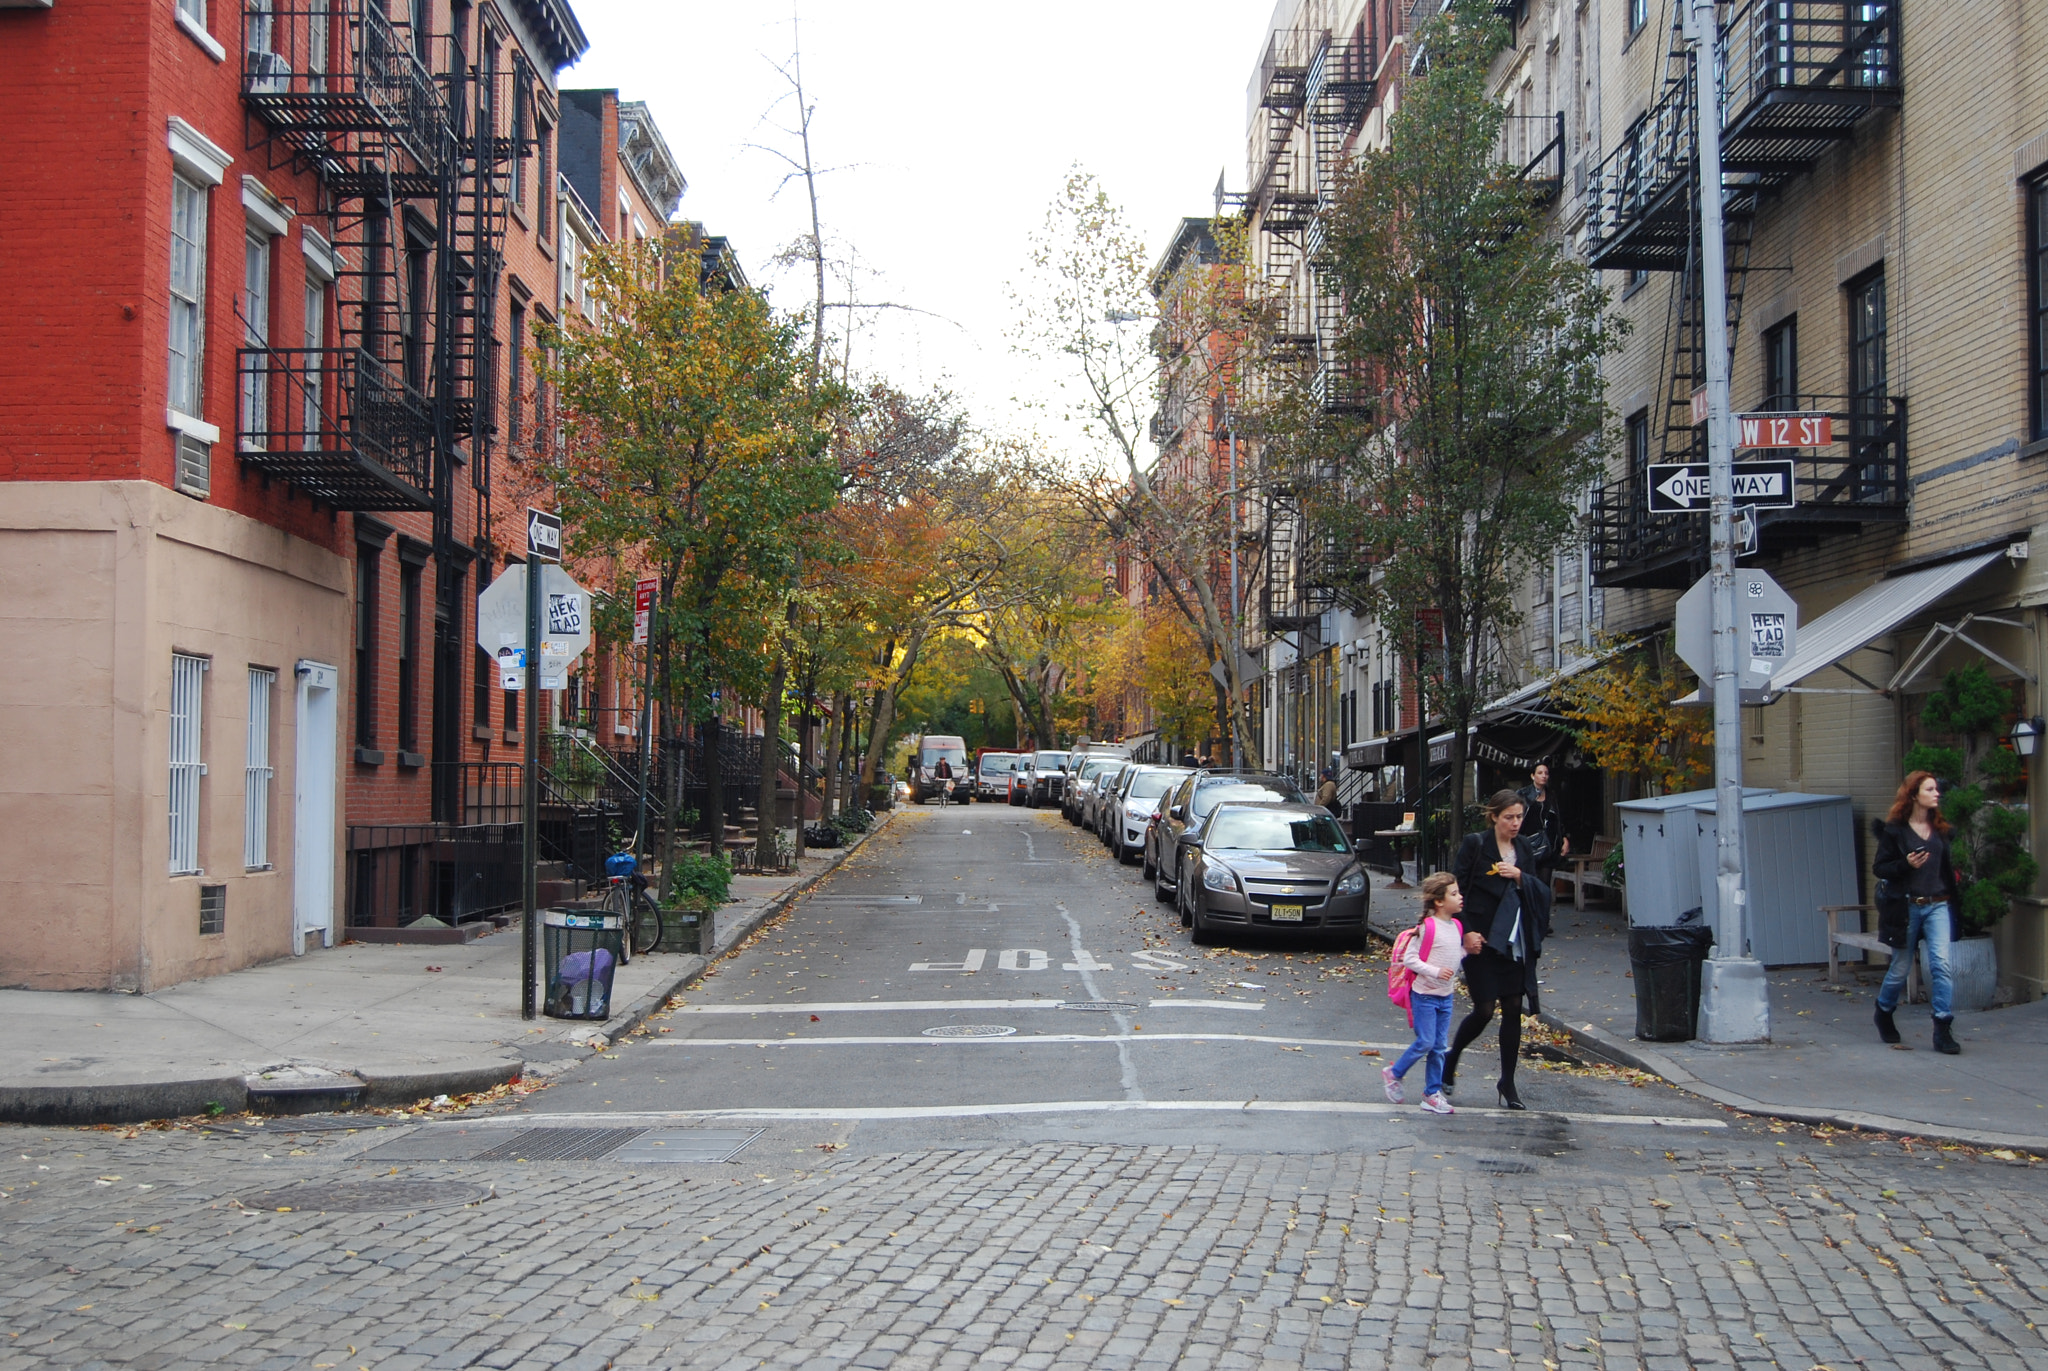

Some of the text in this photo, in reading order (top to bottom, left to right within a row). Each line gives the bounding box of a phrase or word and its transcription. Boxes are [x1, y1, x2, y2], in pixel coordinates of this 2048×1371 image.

[1743, 418, 1822, 445] W 12 ST
[1671, 477, 1773, 496] ONE WAY
[533, 523, 558, 547] ONE WAY
[549, 601, 577, 618] HEK
[553, 614, 580, 631] TAD
[1754, 627, 1784, 641] TAD
[1477, 741, 1509, 765] THE
[908, 948, 1188, 972] STOP
